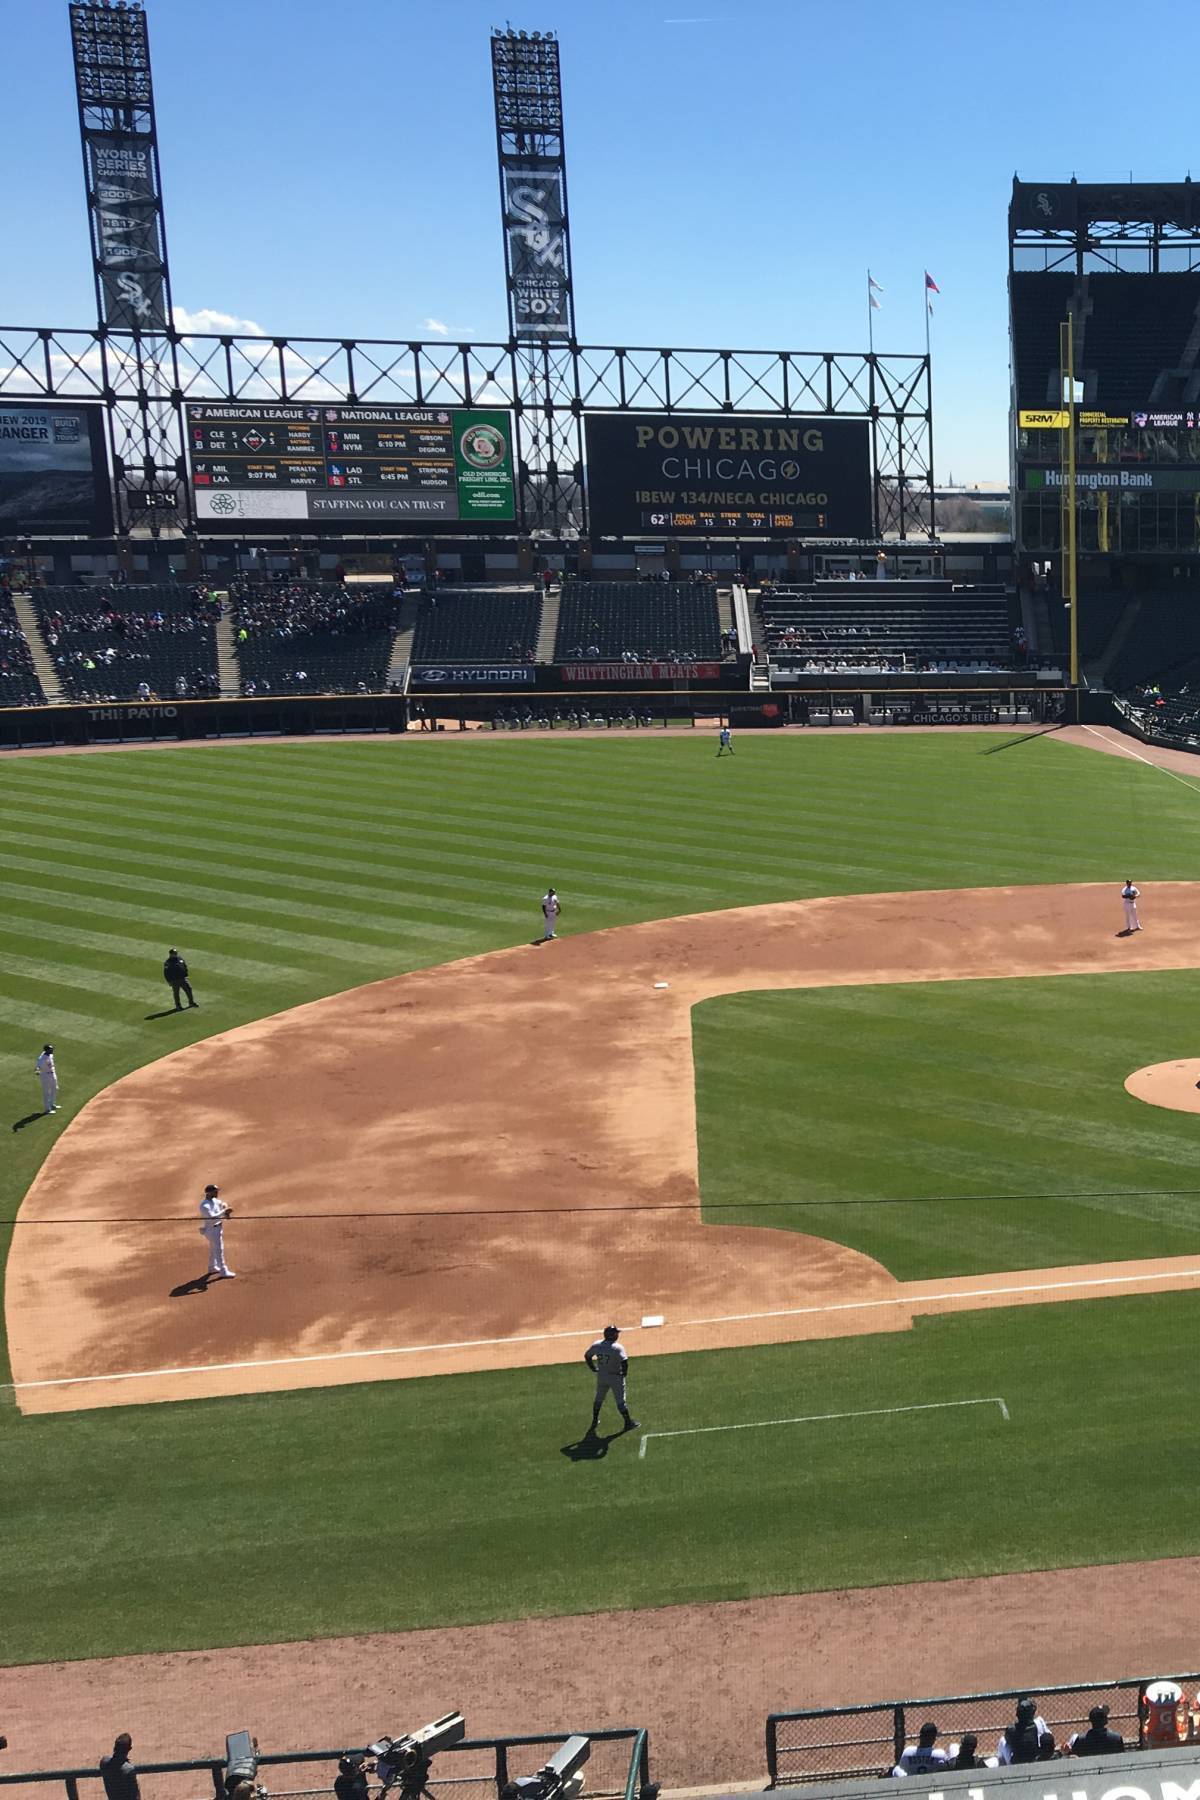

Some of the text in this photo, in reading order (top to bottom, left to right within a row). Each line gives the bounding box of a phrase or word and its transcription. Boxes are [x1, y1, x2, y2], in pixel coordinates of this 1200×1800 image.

[95, 148, 146, 161] WORLD
[96, 158, 147, 172] SERIES
[516, 279, 559, 288] CHICAGO
[516, 288, 560, 299] WHITE
[517, 298, 561, 315] SOX
[205, 408, 304, 419] AMERICAN LEAGUE
[341, 411, 434, 421] NATIONAL LEAGUE
[1024, 414, 1053, 423] SRM
[21, 416, 48, 425] 2019
[209, 431, 225, 439] CLE
[635, 425, 824, 451] POWERING
[342, 443, 363, 451] NYM
[212, 465, 228, 473] MIL
[661, 457, 801, 480] CHICAGO
[212, 475, 230, 483] LAA
[1045, 470, 1153, 490] Hunington Bank
[635, 490, 828, 505] IBEW 134/NECA CHICAGO
[312, 500, 447, 510] STAFFING YOU CAN TRUST
[704, 518, 714, 526] 15
[752, 519, 762, 527] 27
[452, 670, 528, 681] HYUNDAI
[565, 665, 651, 681] WHITTINGHAM
[658, 664, 699, 679] MEATS
[127, 706, 178, 719] PATIO
[912, 712, 997, 724] CHICAGO'S BEER
